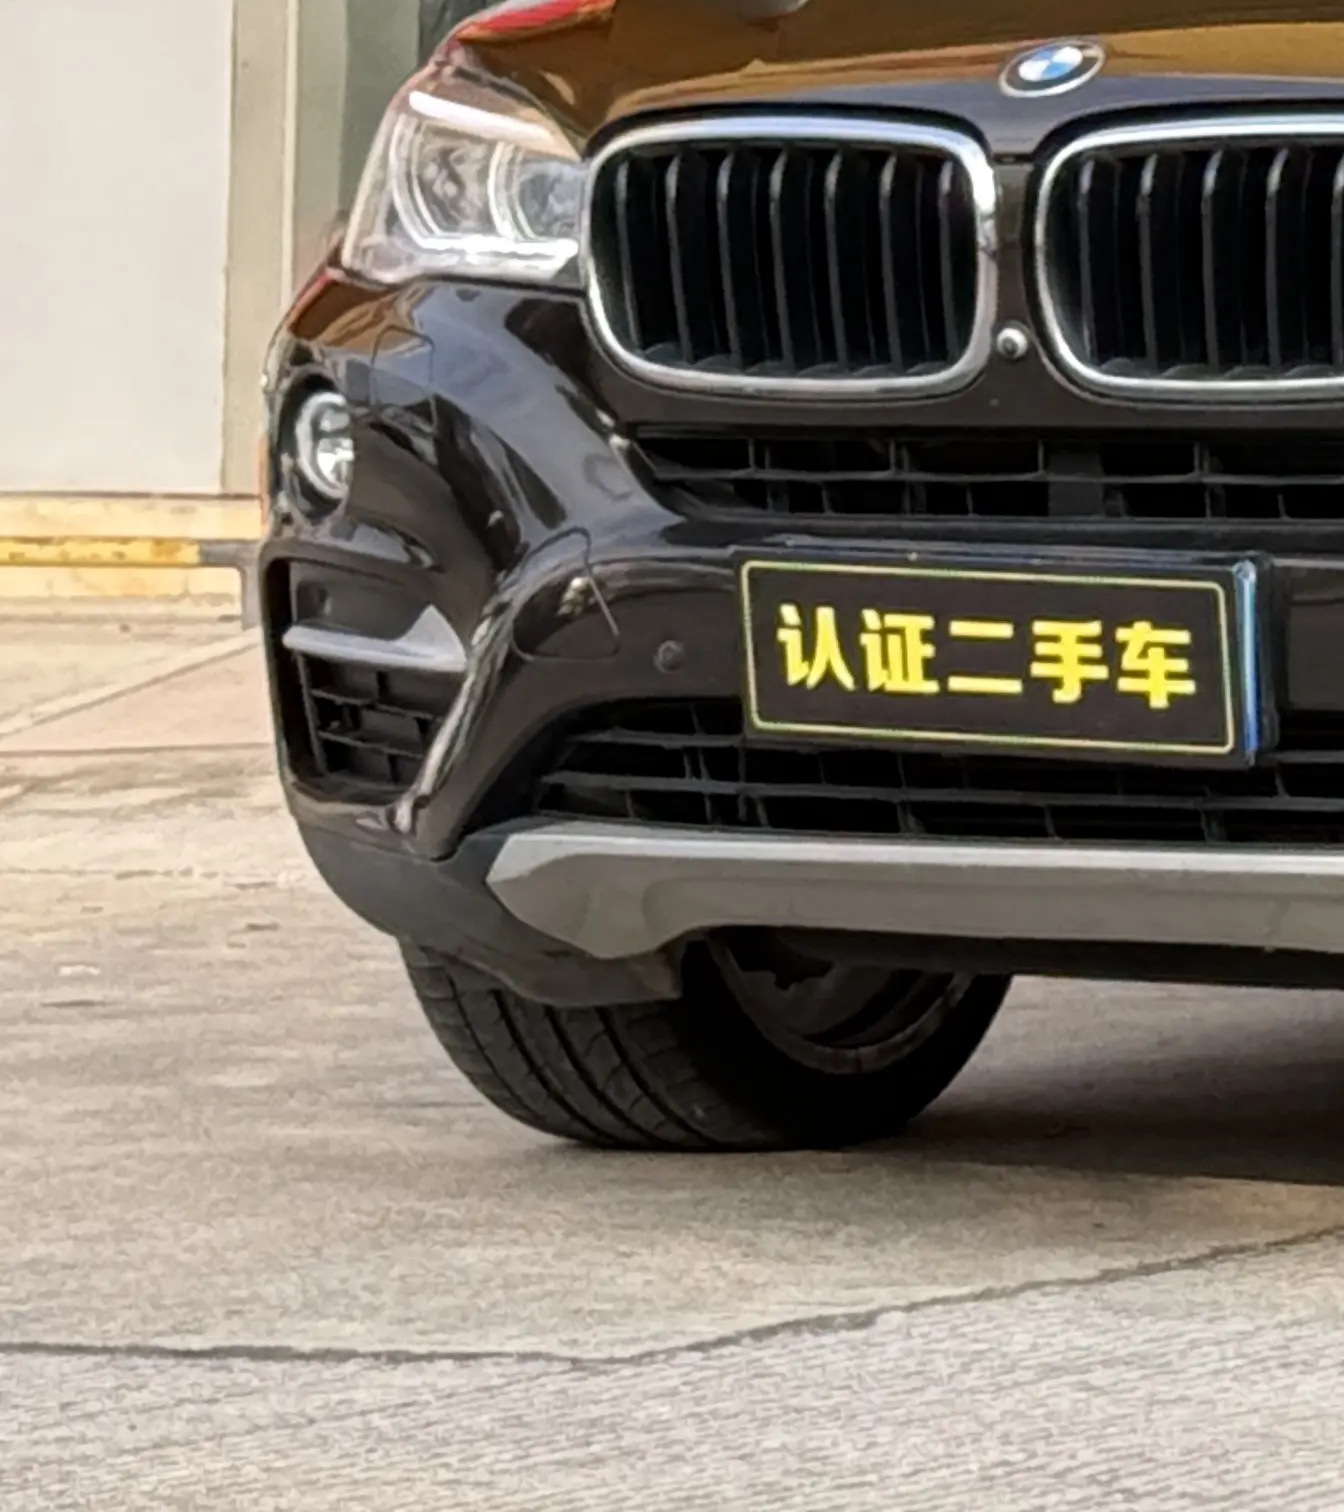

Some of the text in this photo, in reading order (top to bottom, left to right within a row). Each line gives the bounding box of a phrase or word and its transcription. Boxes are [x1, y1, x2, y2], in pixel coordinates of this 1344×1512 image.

[777, 603, 1196, 709] 认证二手车
